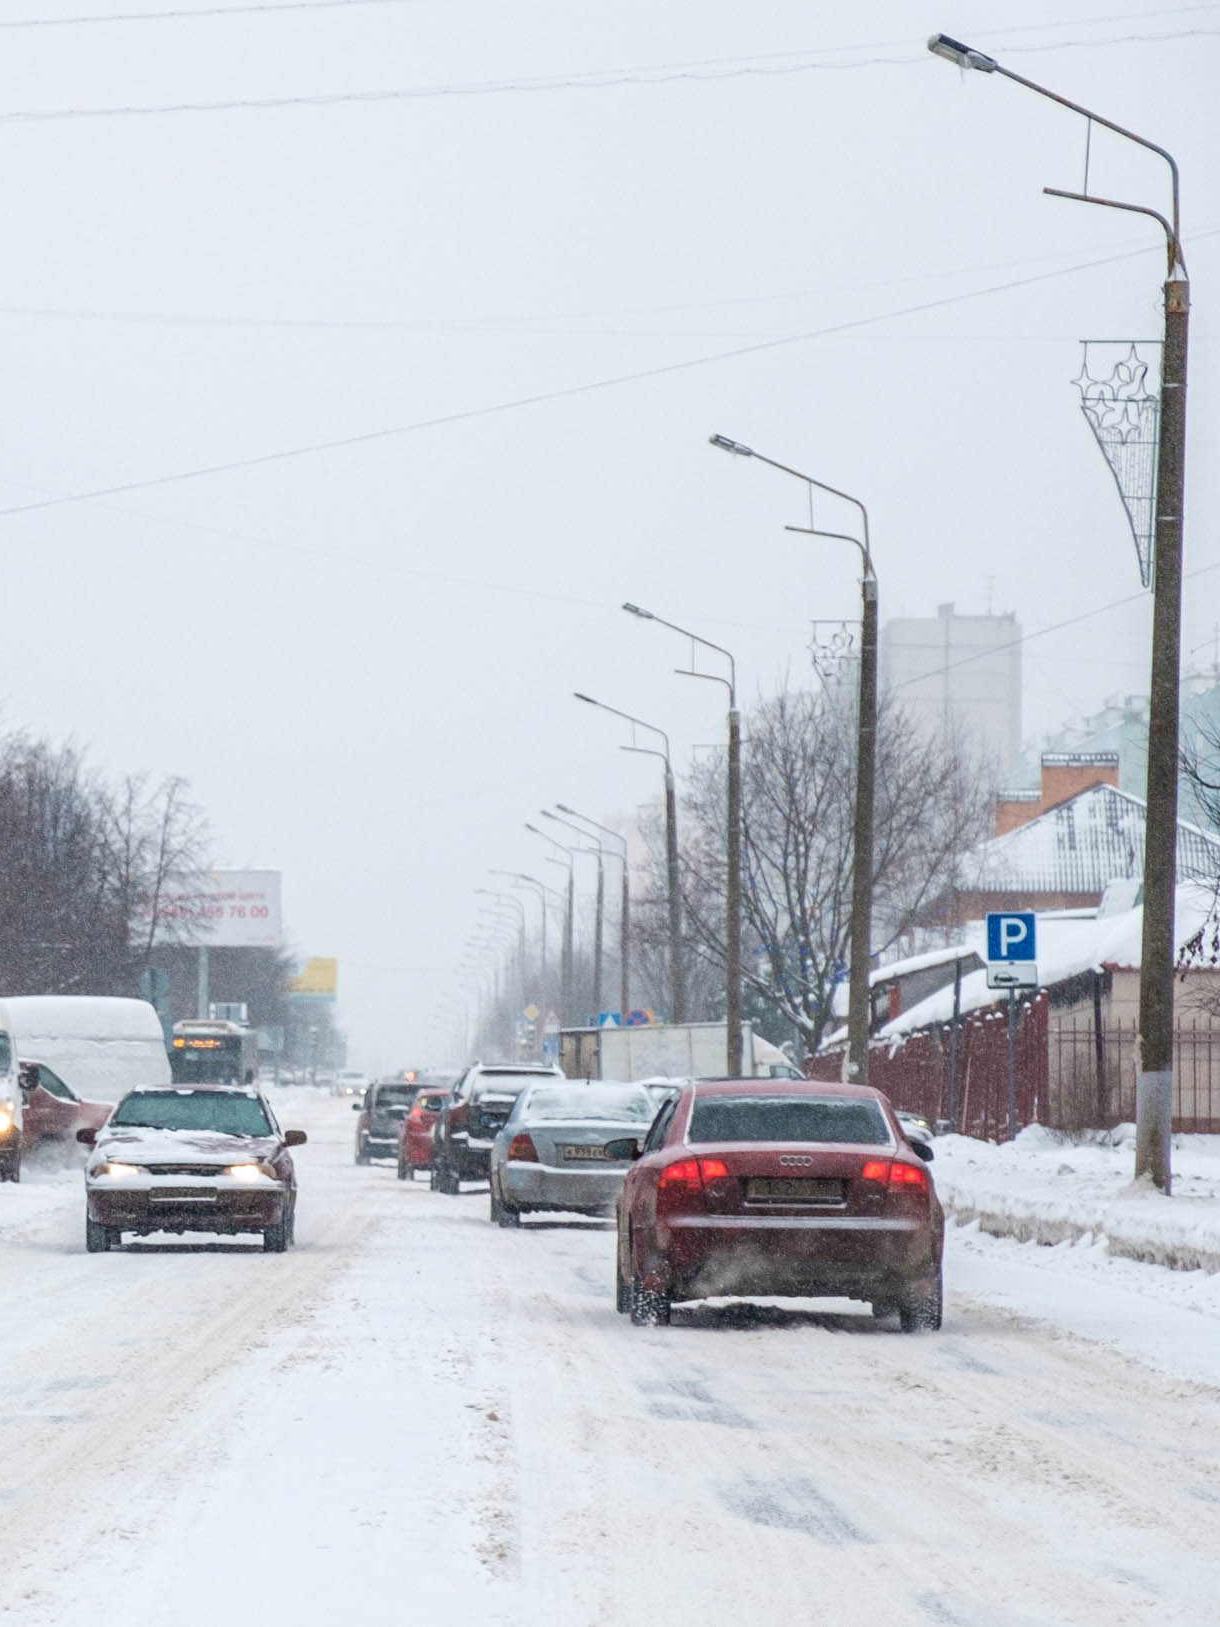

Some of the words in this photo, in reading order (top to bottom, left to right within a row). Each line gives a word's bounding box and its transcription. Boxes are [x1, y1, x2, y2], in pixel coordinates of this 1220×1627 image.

[229, 905, 246, 918] 76
[251, 905, 268, 918] 00
[1000, 917, 1028, 957] P
